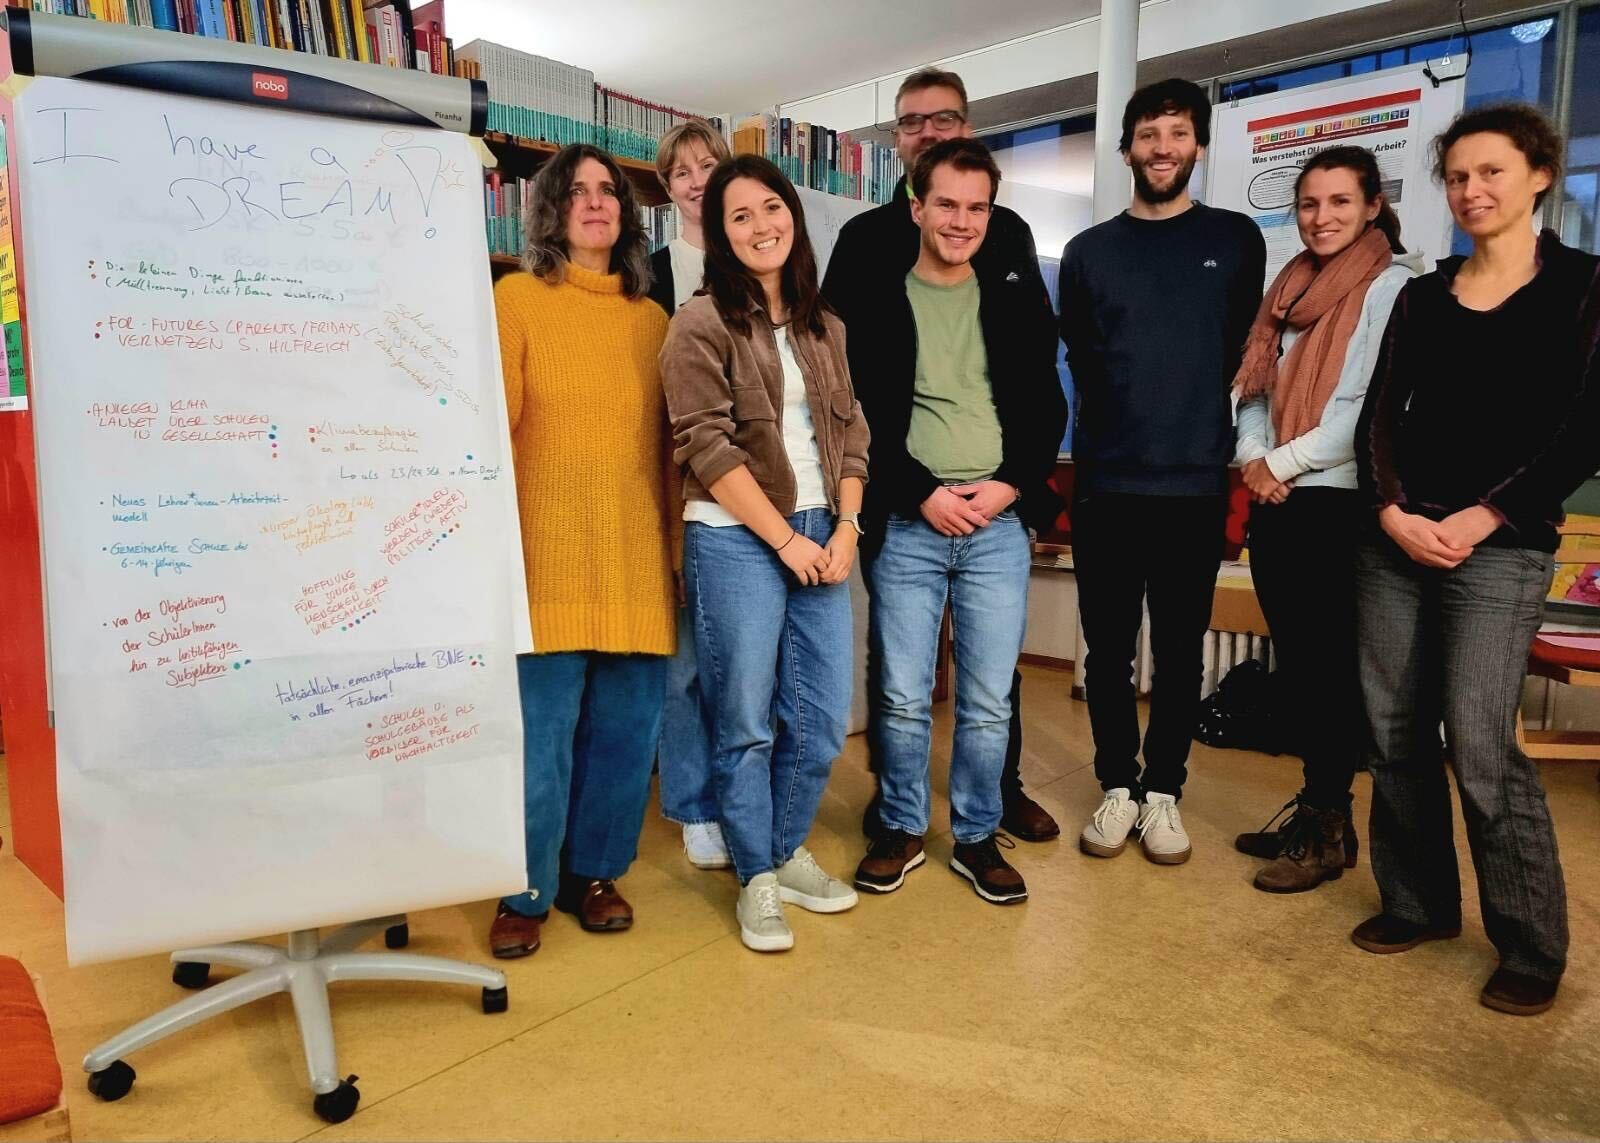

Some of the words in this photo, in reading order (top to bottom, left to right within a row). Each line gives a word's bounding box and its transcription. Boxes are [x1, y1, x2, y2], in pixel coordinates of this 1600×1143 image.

[255, 79, 286, 93] nobo
[435, 111, 463, 122] Piranha
[33, 108, 119, 164] I
[163, 114, 265, 160] have
[310, 147, 349, 173] a
[1252, 155, 1268, 165] Was
[1269, 149, 1307, 162] verstehst
[1374, 139, 1407, 153] Arbeit?
[119, 334, 223, 350] VERNETZEN
[269, 340, 351, 353] HILFREICH
[99, 416, 157, 428] LANDET
[213, 414, 270, 425] SCHULEN
[161, 430, 267, 442] GESELLSCHAFT
[112, 494, 147, 508] Neues
[112, 512, 148, 522] modell
[387, 528, 433, 565] POLITISCH
[439, 500, 469, 527] AKTIV
[302, 569, 355, 597] HOFFNUNG
[294, 600, 318, 615] FÜR
[325, 582, 357, 605] JUNGE
[304, 592, 360, 625] MENSCHEN
[363, 575, 390, 596] DURCH
[112, 617, 129, 628] von
[134, 609, 151, 623] der
[311, 590, 386, 636] WIRKSAMKEIT
[122, 639, 142, 653] der
[147, 621, 217, 647] SchülerInnen
[129, 658, 147, 673] hin
[157, 656, 171, 666] zu
[165, 661, 229, 688] Subjekten
[308, 704, 335, 718] allen
[380, 707, 425, 729] SCHULEN
[364, 713, 448, 747] SCHULGEBÄUDE
[455, 703, 475, 717] ALS
[366, 735, 424, 761] VORBILDER
[429, 725, 450, 738] FÜR
[394, 724, 481, 763] NACHHALTIGKEIT
